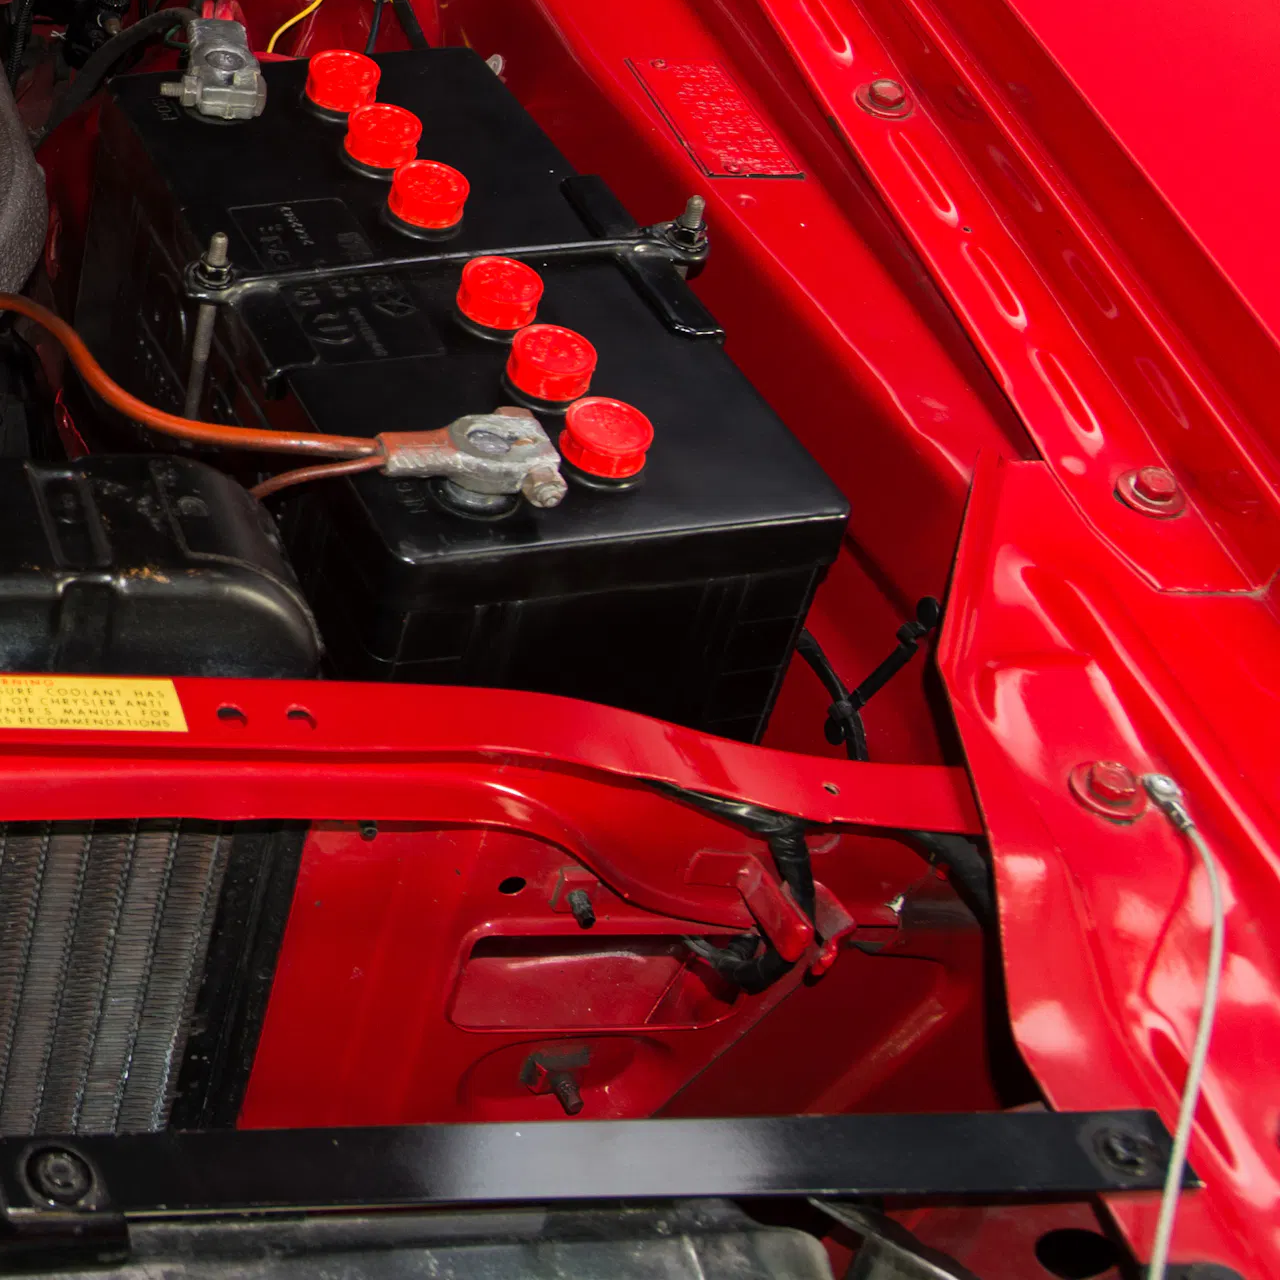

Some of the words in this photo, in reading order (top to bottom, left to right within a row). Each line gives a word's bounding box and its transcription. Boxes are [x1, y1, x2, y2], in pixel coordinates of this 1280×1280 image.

[45, 687, 123, 697] COOLANT
[133, 689, 167, 699] HAS
[11, 696, 32, 706] OF
[39, 696, 118, 707] CHRYSLER
[62, 707, 132, 718] MANUAL
[141, 709, 172, 719] FOR
[18, 716, 173, 729] RECOMMENDATIONS
